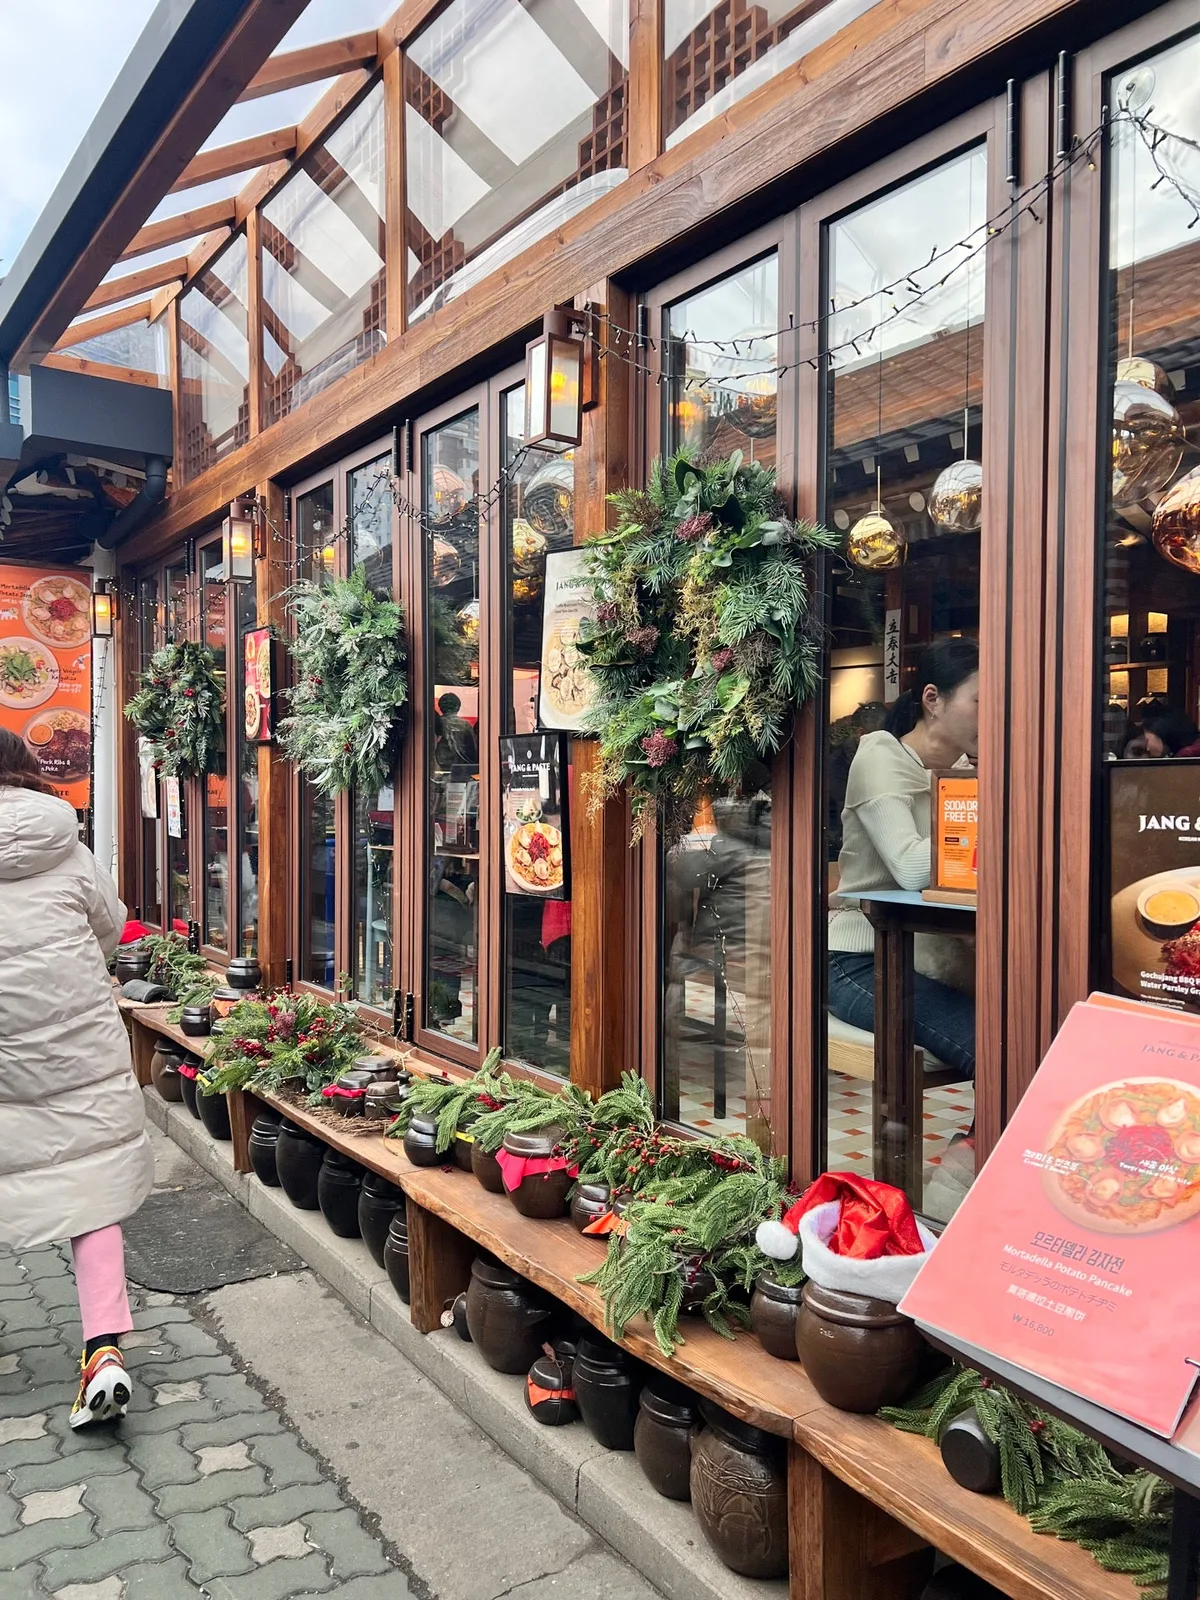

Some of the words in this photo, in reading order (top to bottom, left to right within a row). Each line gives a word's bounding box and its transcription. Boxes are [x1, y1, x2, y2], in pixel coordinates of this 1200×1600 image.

[532, 763, 551, 772] PASTE
[944, 800, 967, 811] SODA
[944, 811, 967, 823] FREE
[1138, 815, 1191, 833] JANG
[1140, 970, 1178, 984] Gochujang
[1178, 974, 1195, 987] BBQ
[1140, 980, 1161, 990] Water
[1162, 983, 1189, 995] Parsley
[1141, 1043, 1176, 1058] JANG
[1177, 1050, 1188, 1060] &
[1030, 1231, 1088, 1262] 모르타델라
[1086, 1249, 1126, 1275] 감자전
[1003, 1244, 1054, 1269] Mortadella
[1054, 1261, 1089, 1282] Potato
[1087, 1273, 1134, 1297] Pancake
[1023, 1317, 1056, 1337] 16,800
